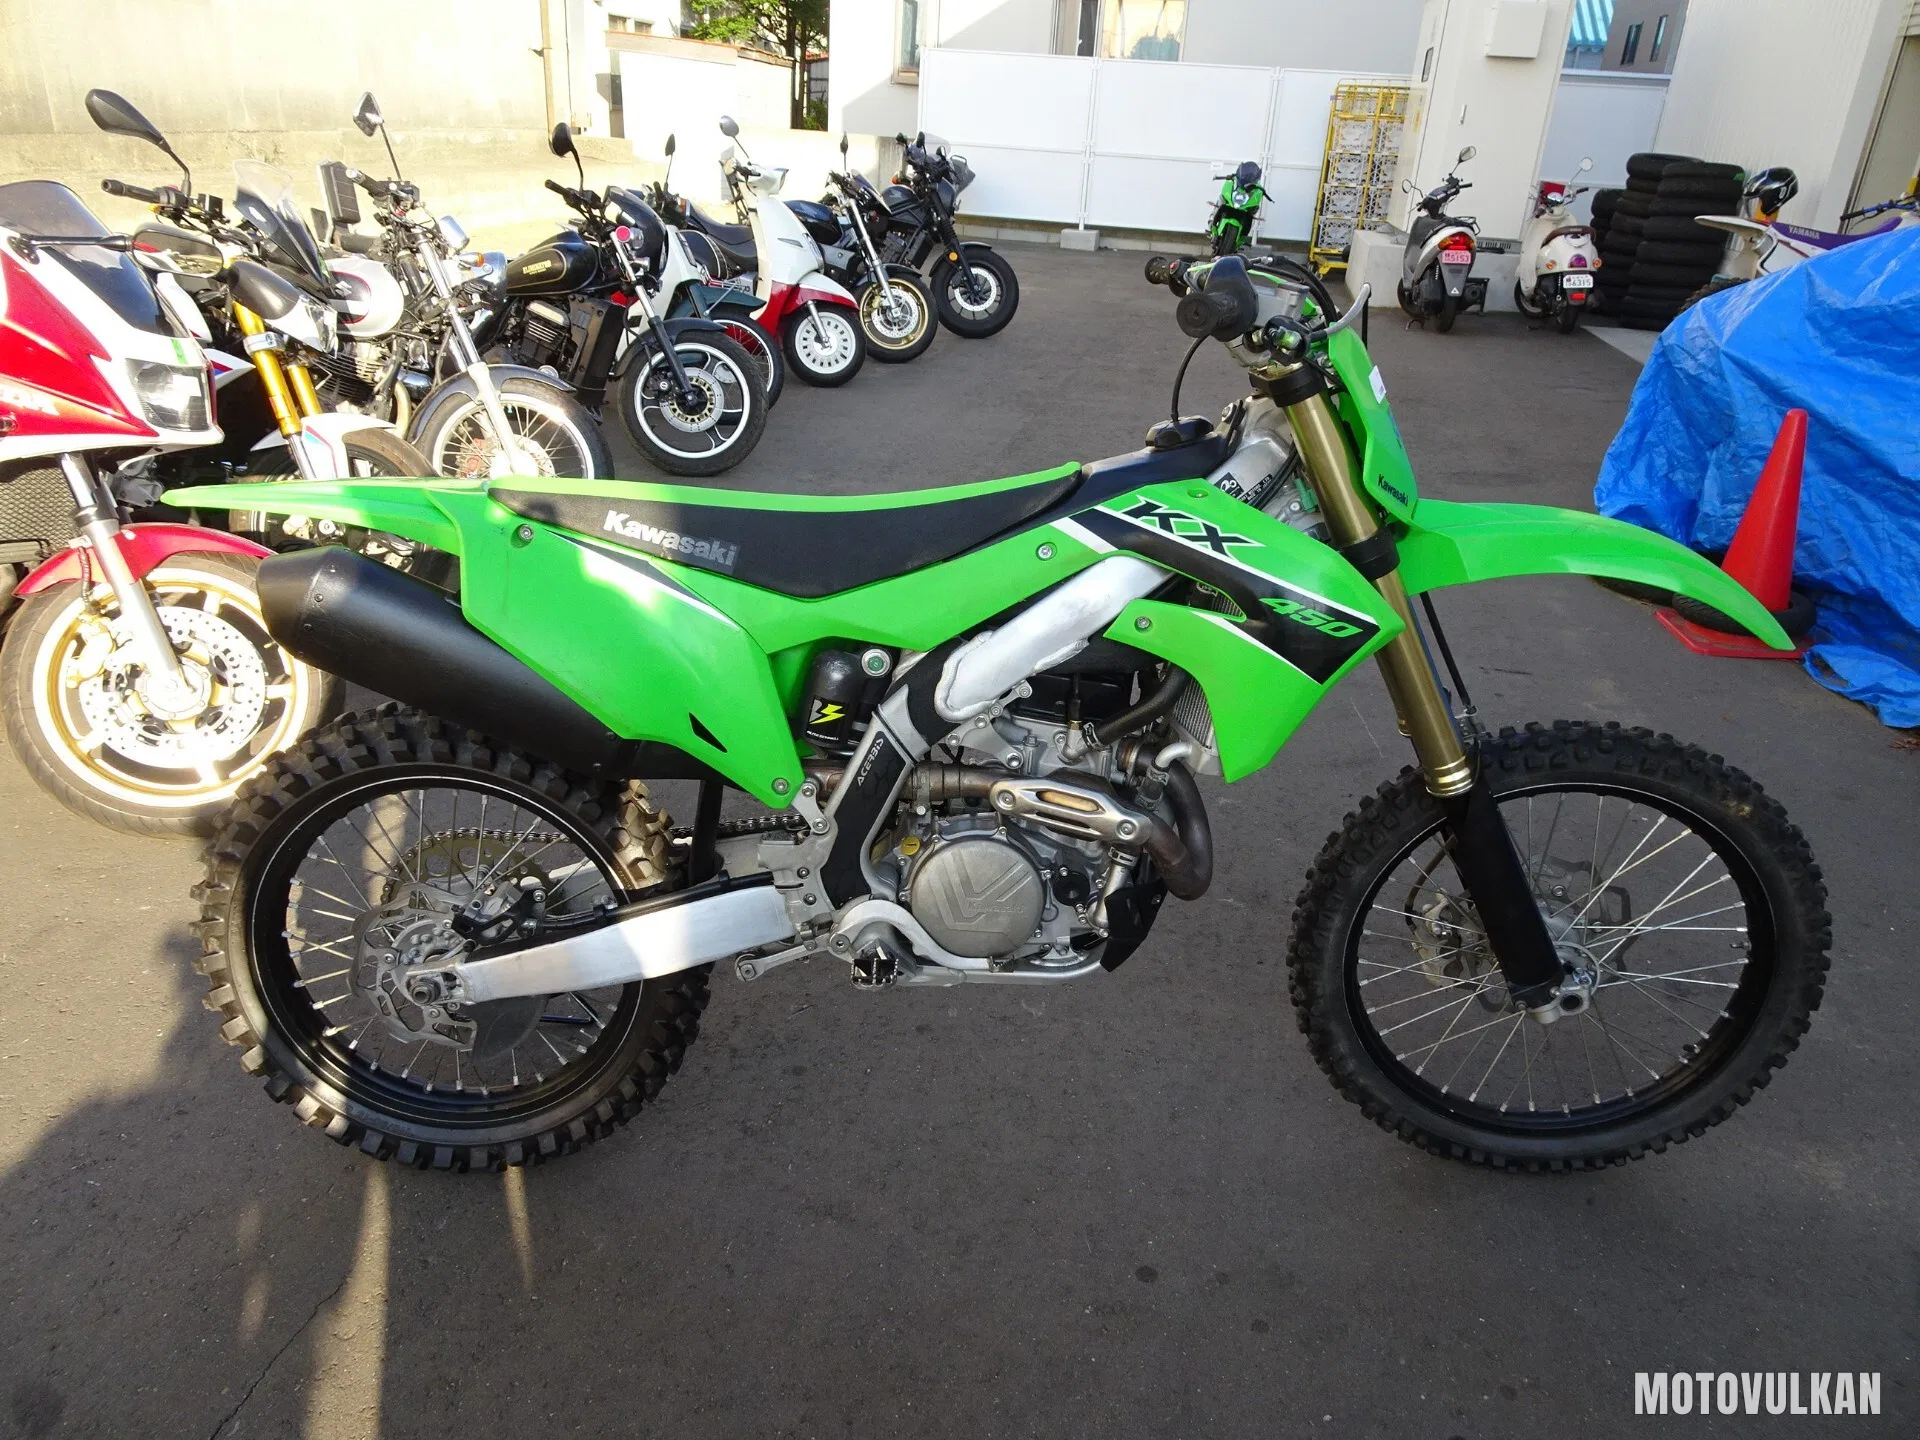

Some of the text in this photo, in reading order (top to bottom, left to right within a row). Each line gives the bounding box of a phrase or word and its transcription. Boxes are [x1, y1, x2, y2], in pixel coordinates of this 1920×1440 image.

[1788, 225, 1820, 239] YAMAHA
[1378, 473, 1408, 507] Kawasaki
[603, 509, 737, 566] Kawasaki
[1121, 496, 1265, 562] KX
[1259, 597, 1363, 637] 450
